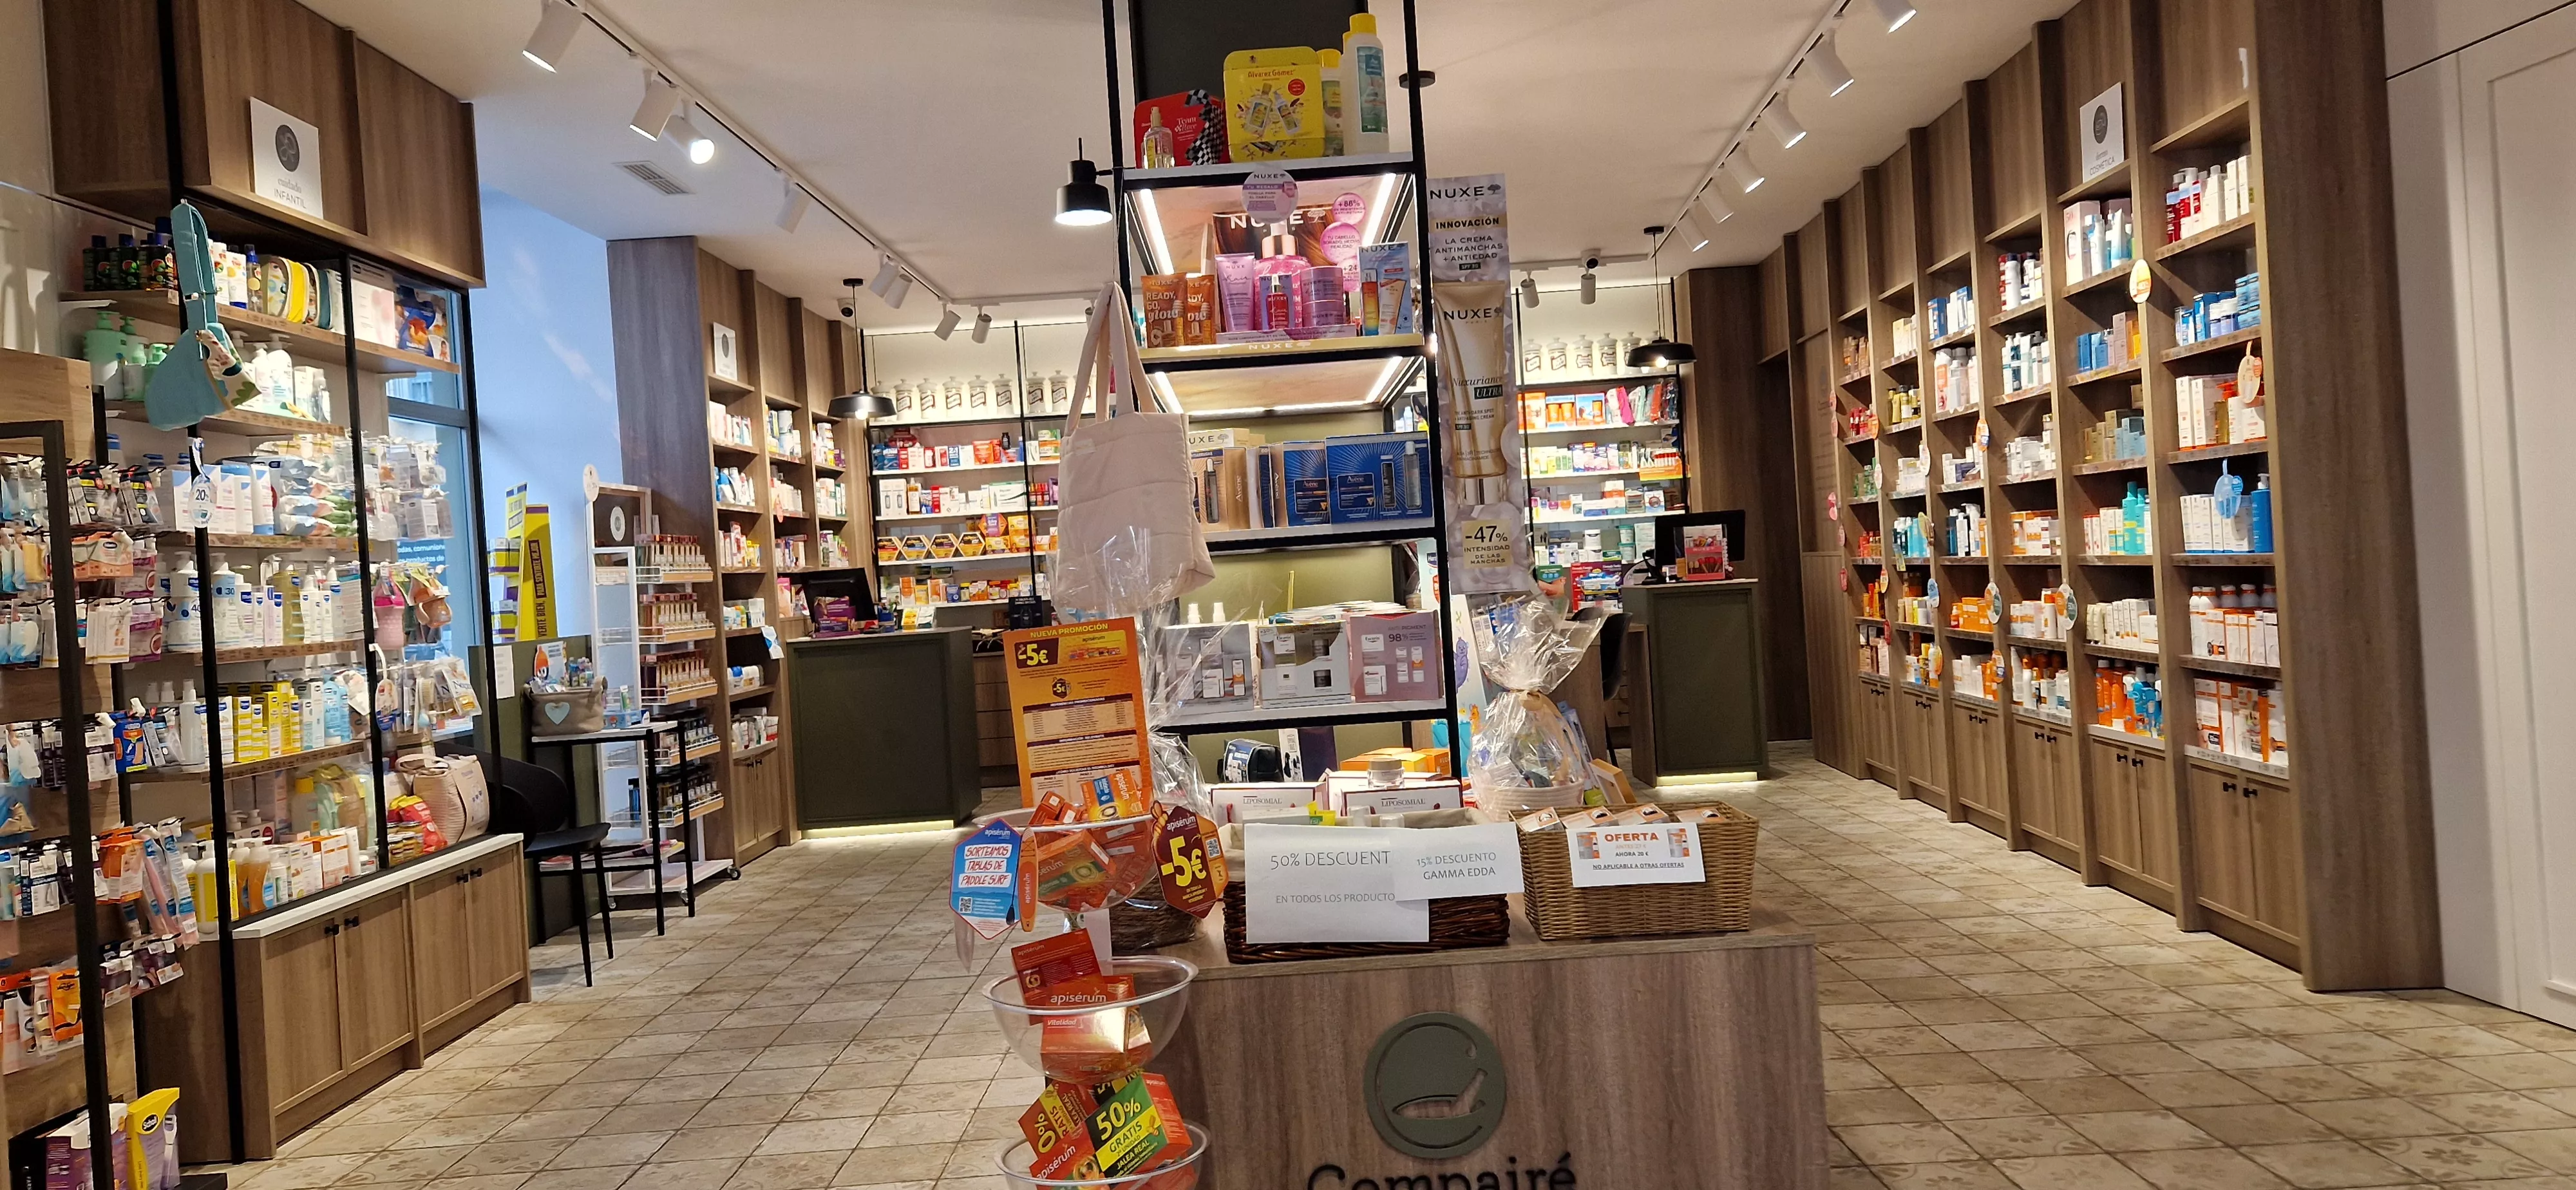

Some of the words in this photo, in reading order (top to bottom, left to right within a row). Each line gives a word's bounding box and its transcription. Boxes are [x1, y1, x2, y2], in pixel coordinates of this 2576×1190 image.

[274, 188, 307, 209] INFANTIL
[1430, 185, 1484, 200] NUXE
[1231, 211, 1304, 229] NUE
[1435, 217, 1500, 229] INNOVACIÓN
[1460, 236, 1493, 244] CREMA
[1361, 244, 1395, 252] NUXE
[1435, 243, 1504, 254] ANTIMANCHAS
[1146, 291, 1176, 301] READY,
[1146, 301, 1160, 311] GO,
[1148, 309, 1179, 322] glow
[1444, 308, 1492, 321] NUXE
[1249, 342, 1293, 350] NUXE
[1453, 376, 1503, 386] Nuxuriance
[1476, 386, 1502, 398] ULTRA
[1189, 435, 1215, 444] UXE
[1465, 525, 1508, 543] -47%
[1464, 544, 1511, 554] INTENSIDAD
[1030, 628, 1057, 638] NUEVA
[1058, 623, 1108, 635] PROMOCIÓN
[1018, 643, 1048, 666] -5€
[1053, 683, 1066, 693] -5€
[1115, 773, 1130, 800] apisérum
[1381, 798, 1426, 807] LIPOSOMIAL
[1166, 814, 1196, 832] apisérum
[985, 827, 1010, 836] apisérum
[1604, 832, 1659, 842] OFERTA
[965, 845, 1009, 857] SORTEAMOS
[967, 860, 993, 870] TABLAS
[994, 860, 1005, 869] DE
[1160, 835, 1207, 887] -5€
[1270, 853, 1300, 871] 50%
[1305, 851, 1391, 867] DESCUENT
[1417, 856, 1433, 868] 15%
[1435, 852, 1497, 865] DESCUENTO
[1038, 858, 1065, 876] sérum
[1423, 869, 1466, 880] GAMMA
[1467, 867, 1497, 878] EDDA
[960, 874, 989, 885] PADDLE
[988, 874, 1009, 885] SURF
[1023, 873, 1032, 904] apisérum
[1276, 894, 1288, 903] EN
[1290, 894, 1322, 903] TODOS
[1324, 893, 1342, 903] LOS
[1343, 892, 1396, 903] PRODUCTO
[1018, 945, 1045, 956] apisérum
[1050, 990, 1106, 1005] apisérum
[1049, 1105, 1070, 1137] RATIS
[1096, 1097, 1141, 1141] 50%
[1034, 1113, 1056, 1153] 0%
[1109, 1120, 1142, 1153] GRATIS
[1117, 1153, 1135, 1169] JALEA
[1134, 1140, 1150, 1155] REAL
